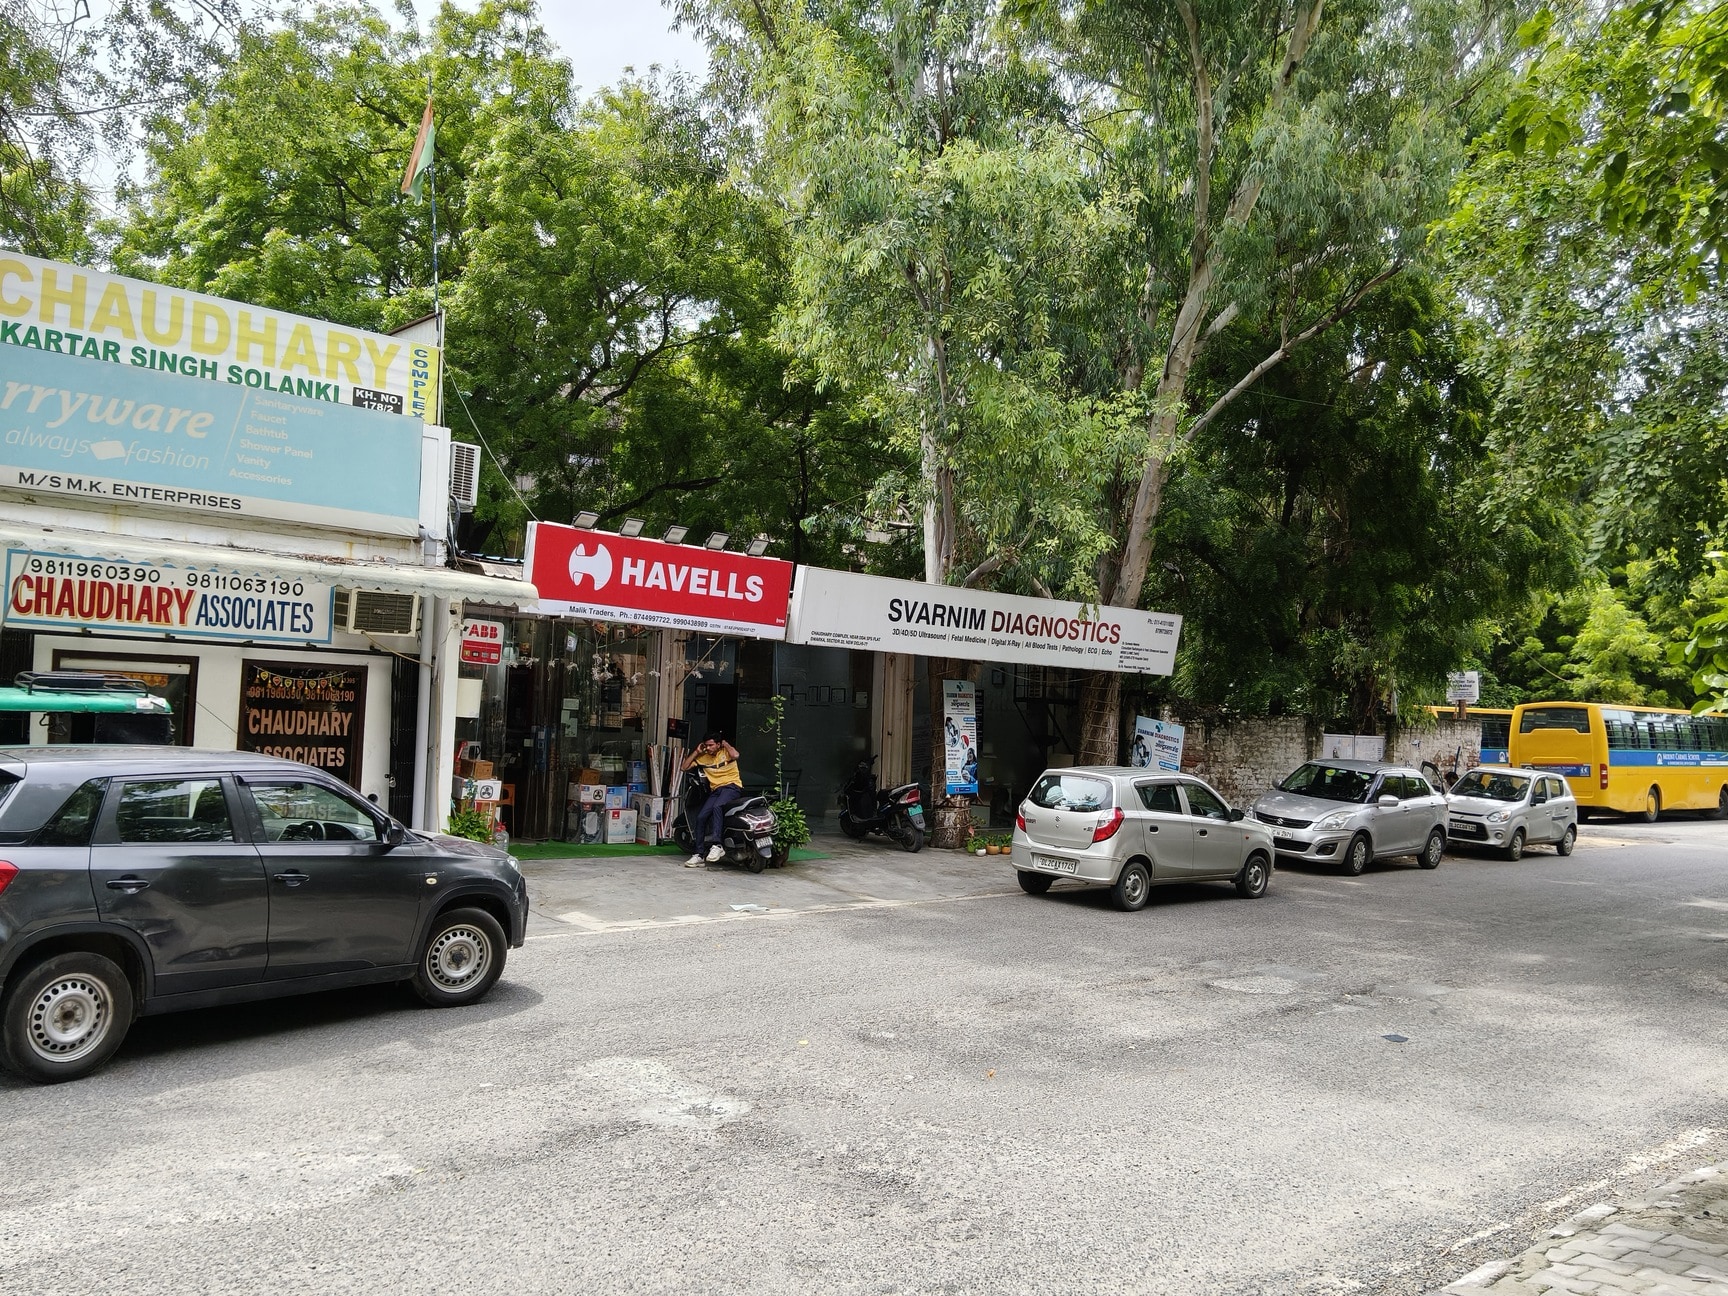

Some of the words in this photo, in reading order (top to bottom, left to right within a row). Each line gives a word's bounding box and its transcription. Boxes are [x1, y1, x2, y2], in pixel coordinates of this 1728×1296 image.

[0, 259, 401, 390] CHAUDHARY
[1, 320, 120, 364] KARTAR
[130, 346, 218, 381] SINGH
[227, 365, 340, 404] SOLANKI
[255, 395, 324, 417] Sanitaryware
[362, 400, 394, 413] 178/2
[380, 394, 401, 406] NO.
[250, 410, 288, 425] Faucet
[246, 424, 288, 440] Bathtub
[6, 426, 91, 458] always
[124, 440, 209, 470] fashion
[240, 438, 281, 454] Shower
[284, 445, 313, 459] Panel
[236, 453, 271, 470] Vanity
[229, 468, 292, 486] Accessories
[18, 471, 61, 489] M/S
[67, 478, 106, 494] M.K.
[112, 484, 241, 511] ENTERPRISES
[186, 573, 304, 596] 9811063190
[621, 557, 764, 602] HAVELLS
[12, 574, 196, 626] CHAUDHARY
[195, 594, 314, 634] ASSOCIATES
[569, 605, 587, 615] Malik
[469, 624, 498, 639] ABB
[888, 598, 986, 631] SVARNIM
[991, 610, 1121, 645] DIAGNOSTICS
[918, 630, 947, 641] Ultrasound
[951, 634, 964, 642] Fetal
[964, 636, 987, 645] Medicine
[991, 638, 1006, 647] Digital
[1007, 639, 1021, 649] X-Ray
[1032, 642, 1046, 650] Blood
[1046, 643, 1058, 651] Tests
[1062, 645, 1084, 655] Pathology
[1087, 647, 1098, 655] ECG
[1101, 648, 1113, 656] Echo
[248, 708, 353, 737] CHAUDHARY
